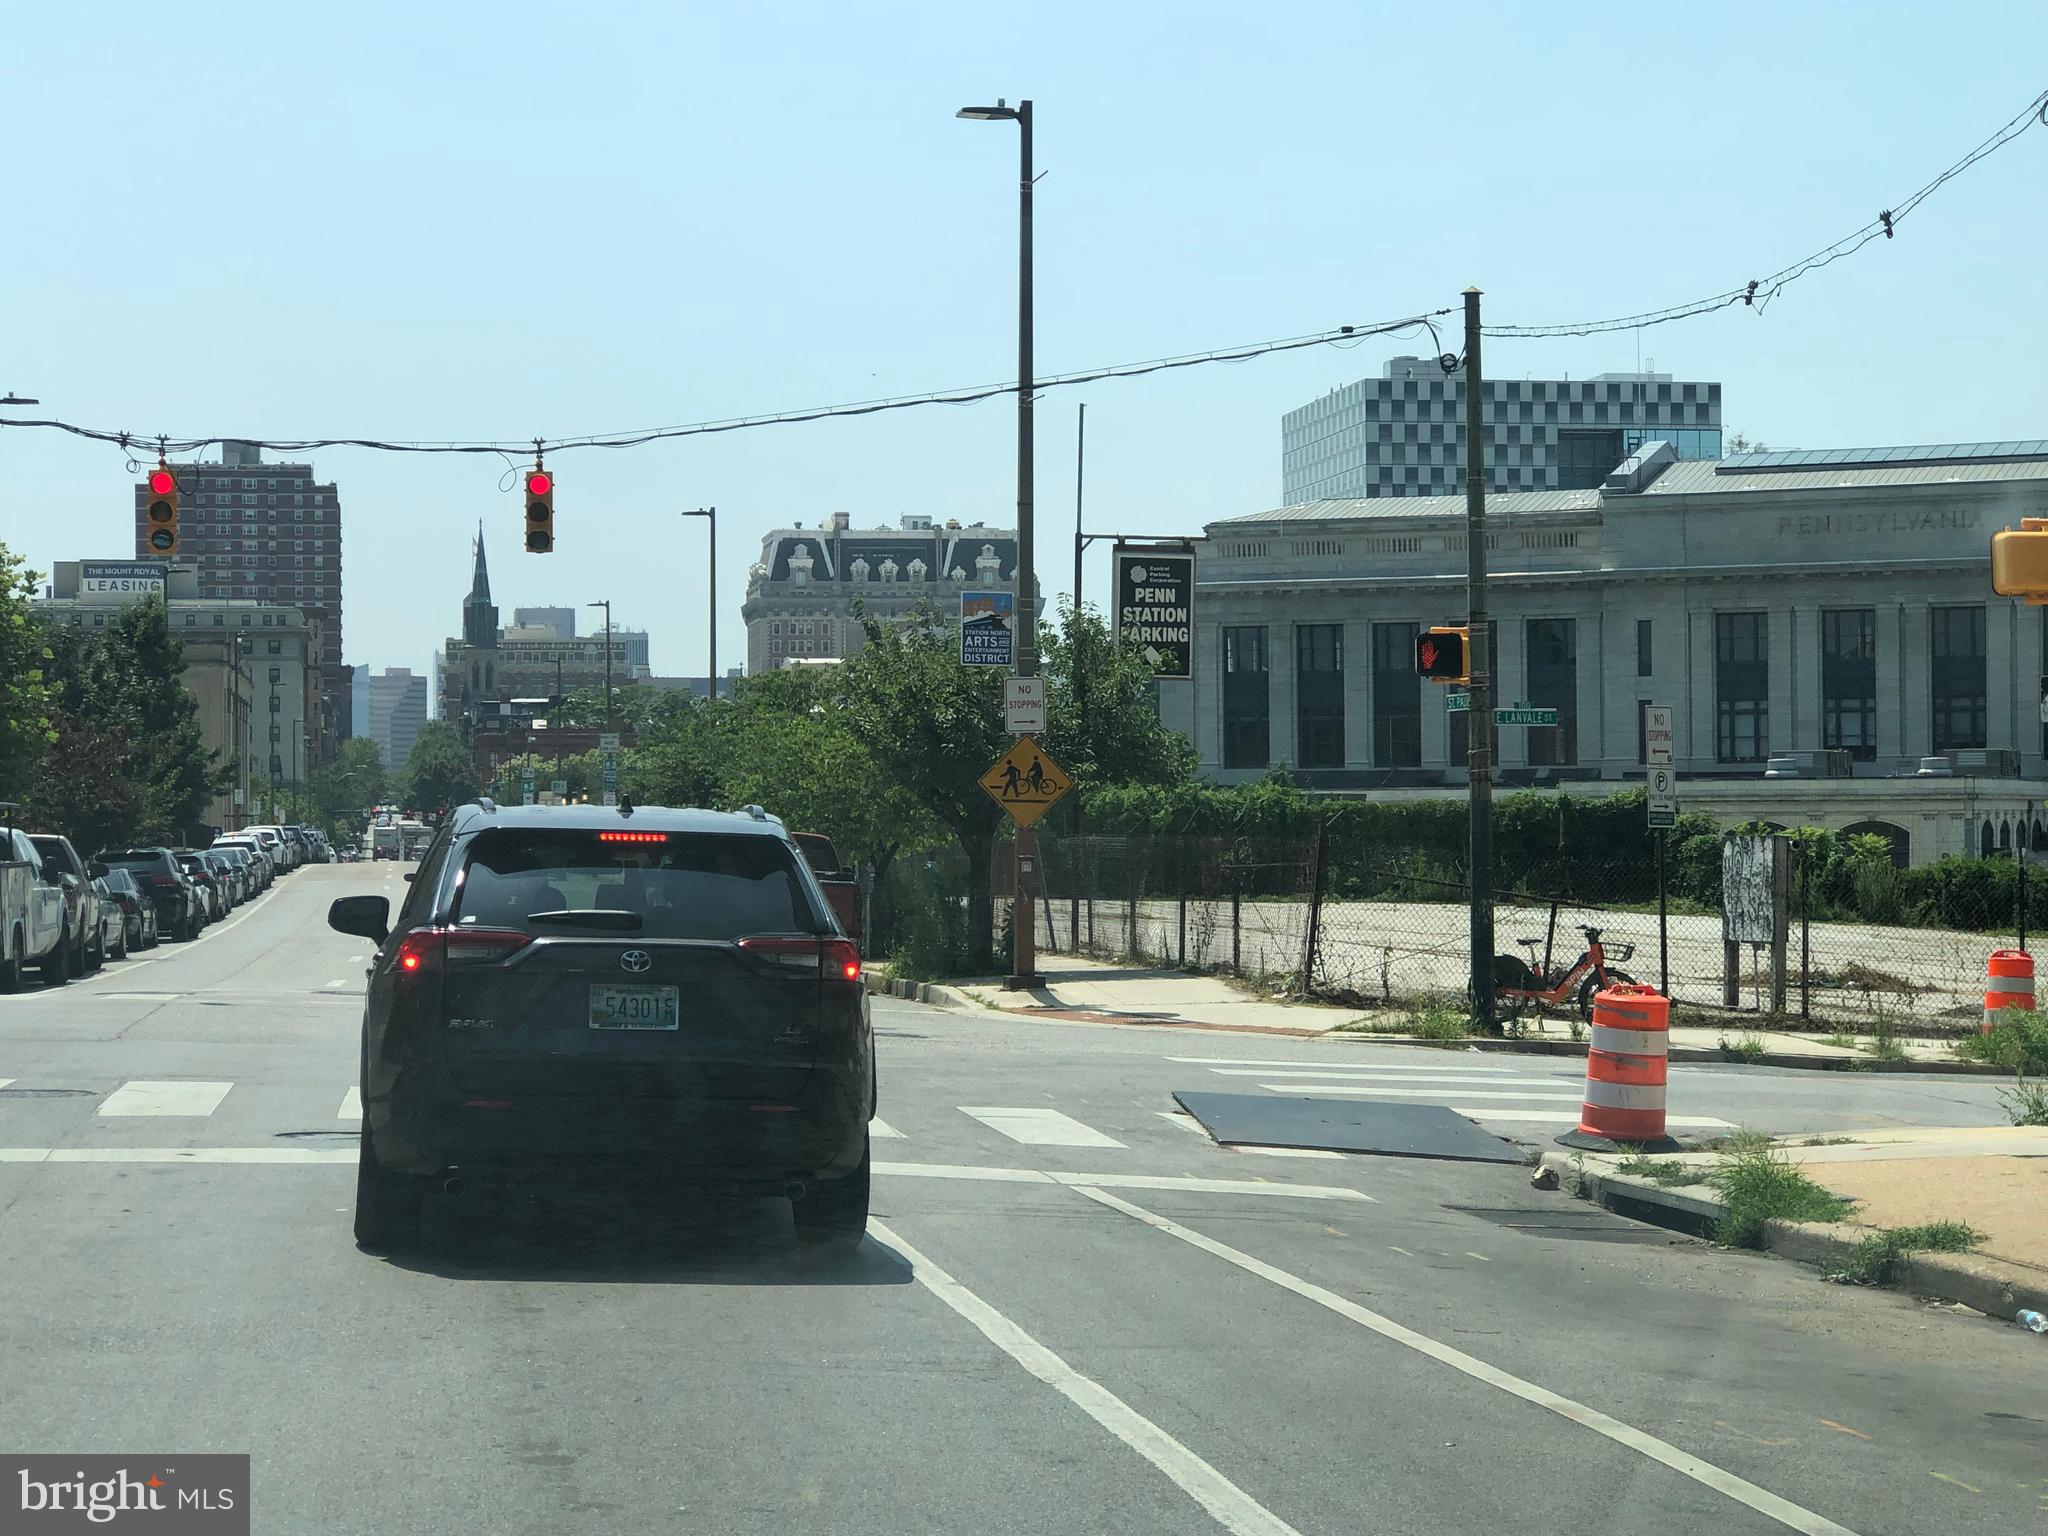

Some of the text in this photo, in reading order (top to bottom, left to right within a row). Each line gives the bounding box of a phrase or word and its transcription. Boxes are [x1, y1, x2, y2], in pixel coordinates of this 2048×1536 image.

[87, 580, 161, 591] LEASING
[1134, 587, 1176, 603] PENN
[1122, 606, 1188, 623] STATION
[964, 636, 998, 647] ARTS
[964, 654, 1010, 663] DISTRICT
[1018, 685, 1032, 694] NO
[1008, 699, 1042, 710] STOPPING
[1505, 712, 1543, 723] LANVALE
[1654, 713, 1665, 726] NO
[1648, 729, 1672, 741] STOPPING
[1657, 775, 1665, 788] P
